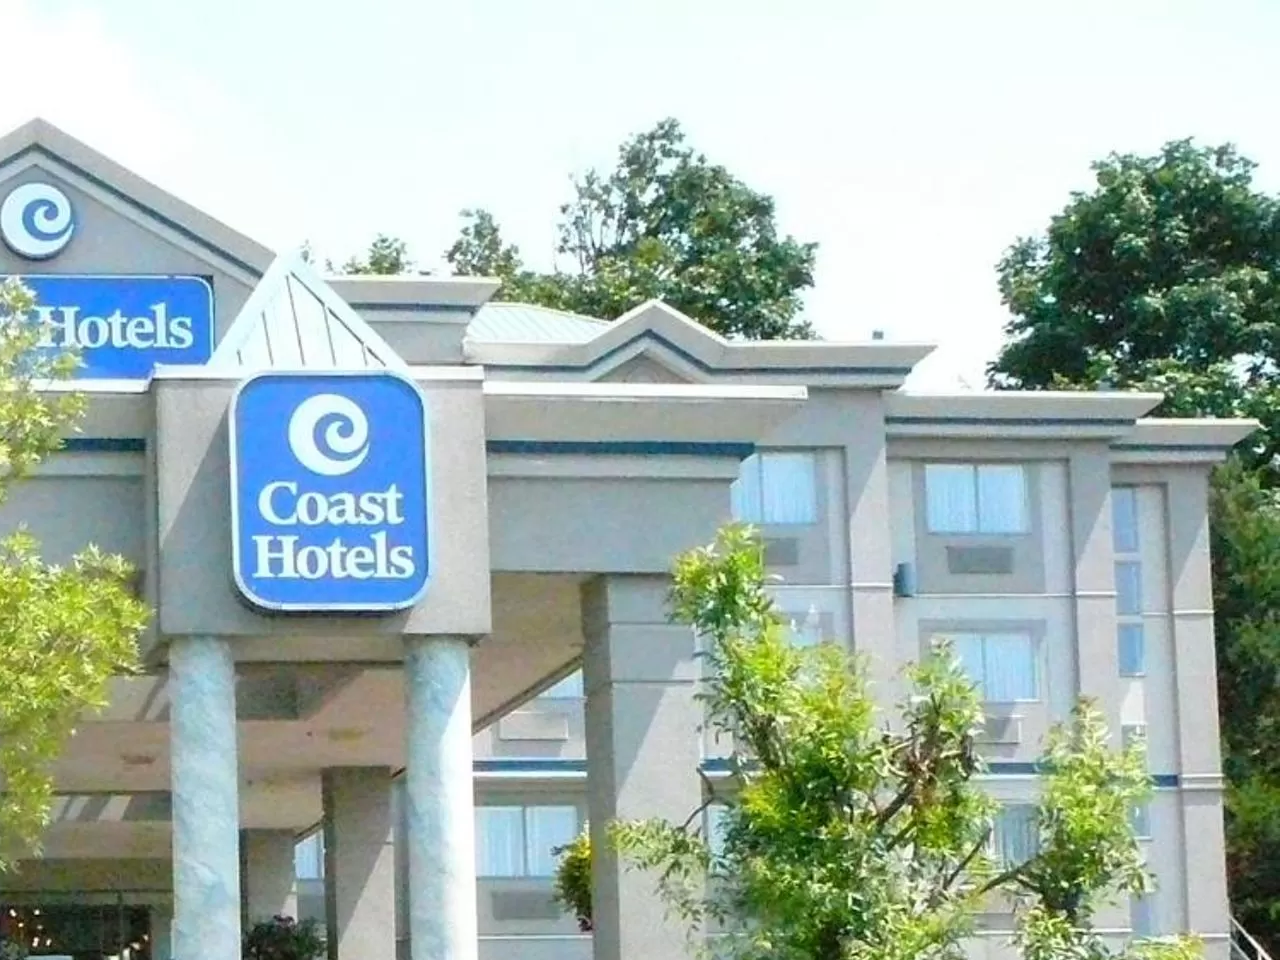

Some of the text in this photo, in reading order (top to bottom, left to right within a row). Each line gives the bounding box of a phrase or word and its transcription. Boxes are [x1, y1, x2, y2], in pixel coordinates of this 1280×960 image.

[34, 302, 194, 349] Hotels
[258, 480, 404, 526] Coast
[252, 532, 415, 580] Hotels
